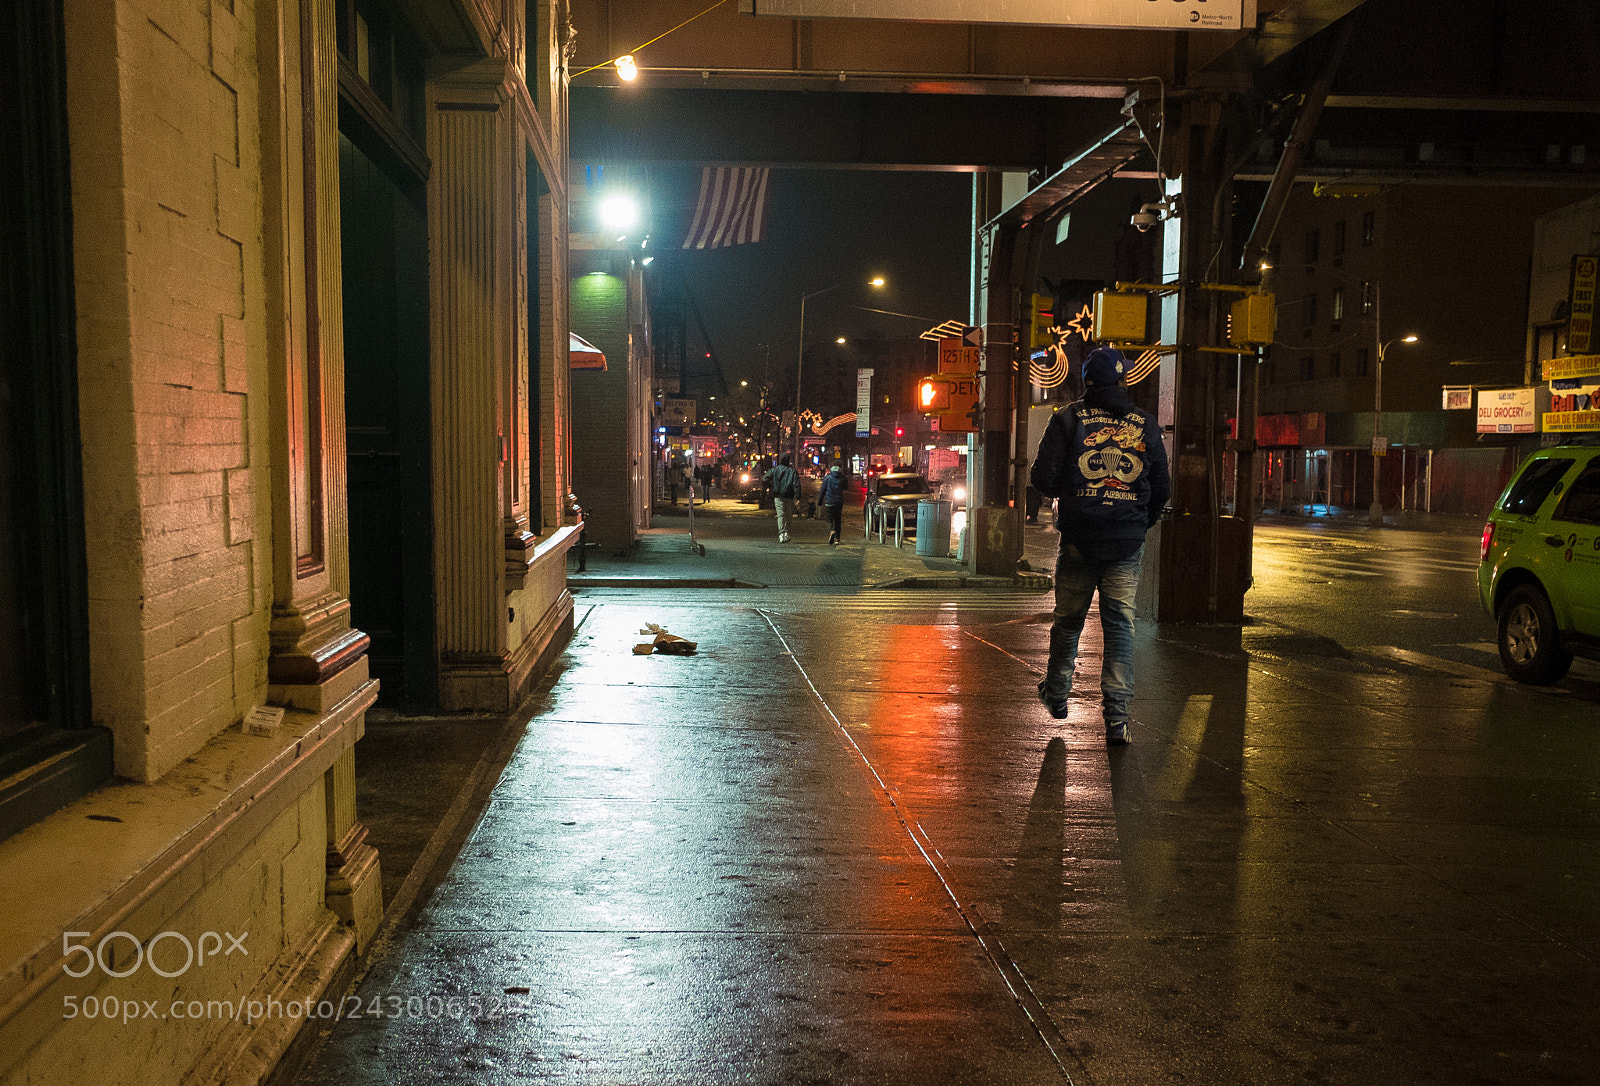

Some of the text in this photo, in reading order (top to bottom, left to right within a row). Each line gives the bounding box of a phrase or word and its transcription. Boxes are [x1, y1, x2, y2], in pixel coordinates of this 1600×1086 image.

[1575, 290, 1592, 301] FAST
[1573, 302, 1592, 313] CASH
[943, 350, 970, 363] 125TH
[1551, 394, 1575, 412] Cell
[1478, 407, 1492, 418] DELI
[1494, 406, 1525, 418] GROCERY
[1545, 414, 1560, 424] CASA
[1562, 414, 1570, 424] DE
[1103, 490, 1138, 500] AIRBORNE
